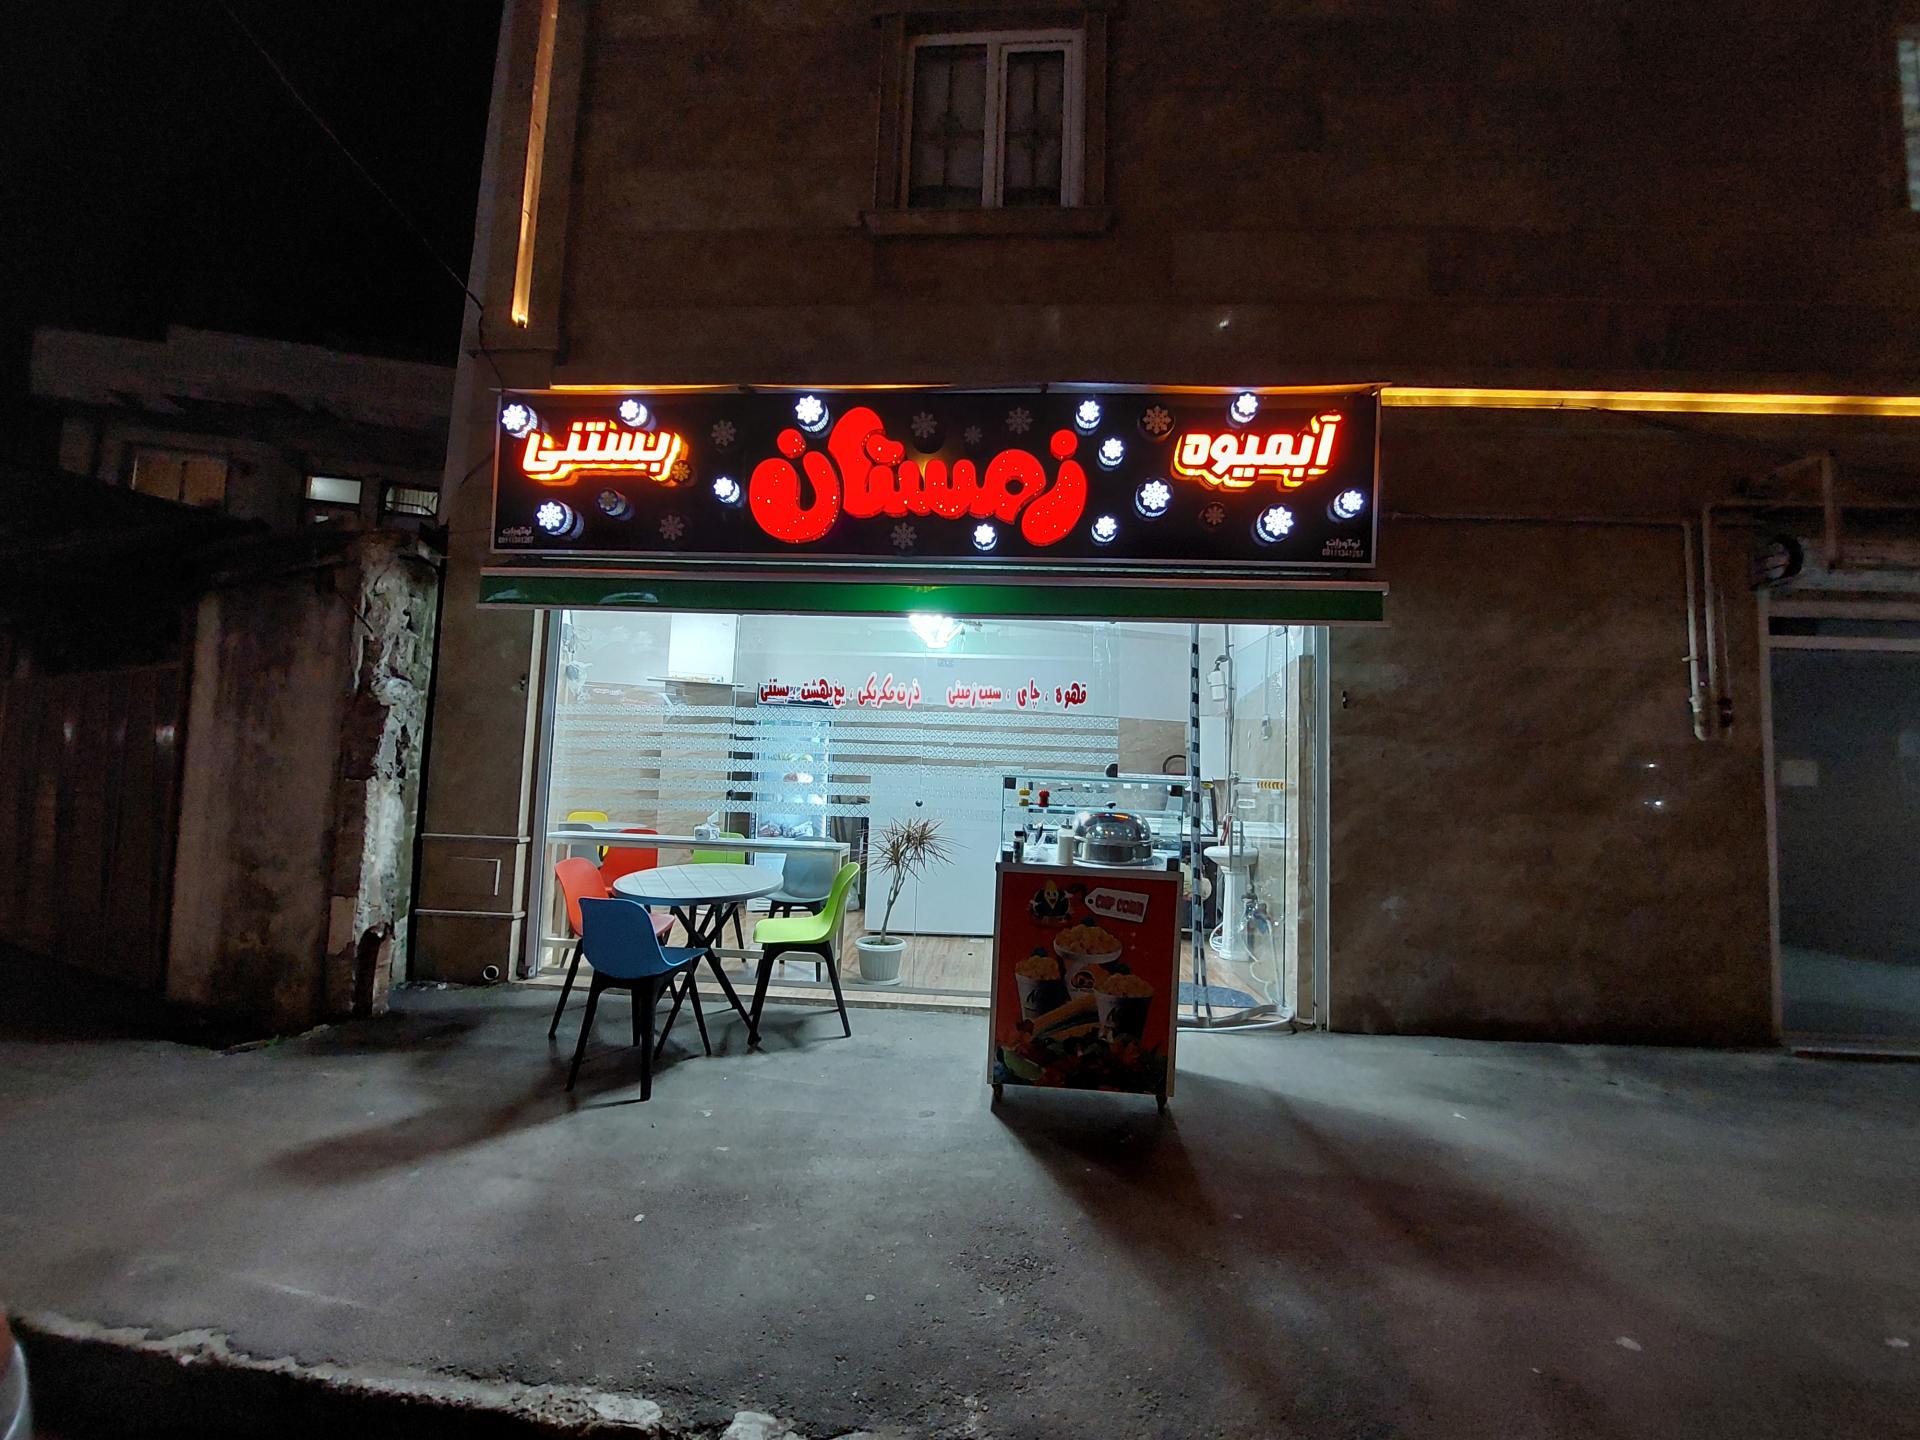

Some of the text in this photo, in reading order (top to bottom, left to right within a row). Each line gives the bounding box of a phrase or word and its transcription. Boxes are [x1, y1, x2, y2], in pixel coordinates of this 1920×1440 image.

[521, 420, 680, 480] بستنی
[1177, 413, 1343, 482] آبمیوه
[750, 406, 1087, 546] زمستان
[760, 678, 790, 703] بستنی
[857, 675, 895, 706] مکزیکی
[897, 679, 920, 707] ذرت
[1017, 679, 1041, 709] چای
[1055, 682, 1087, 709] قهوه
